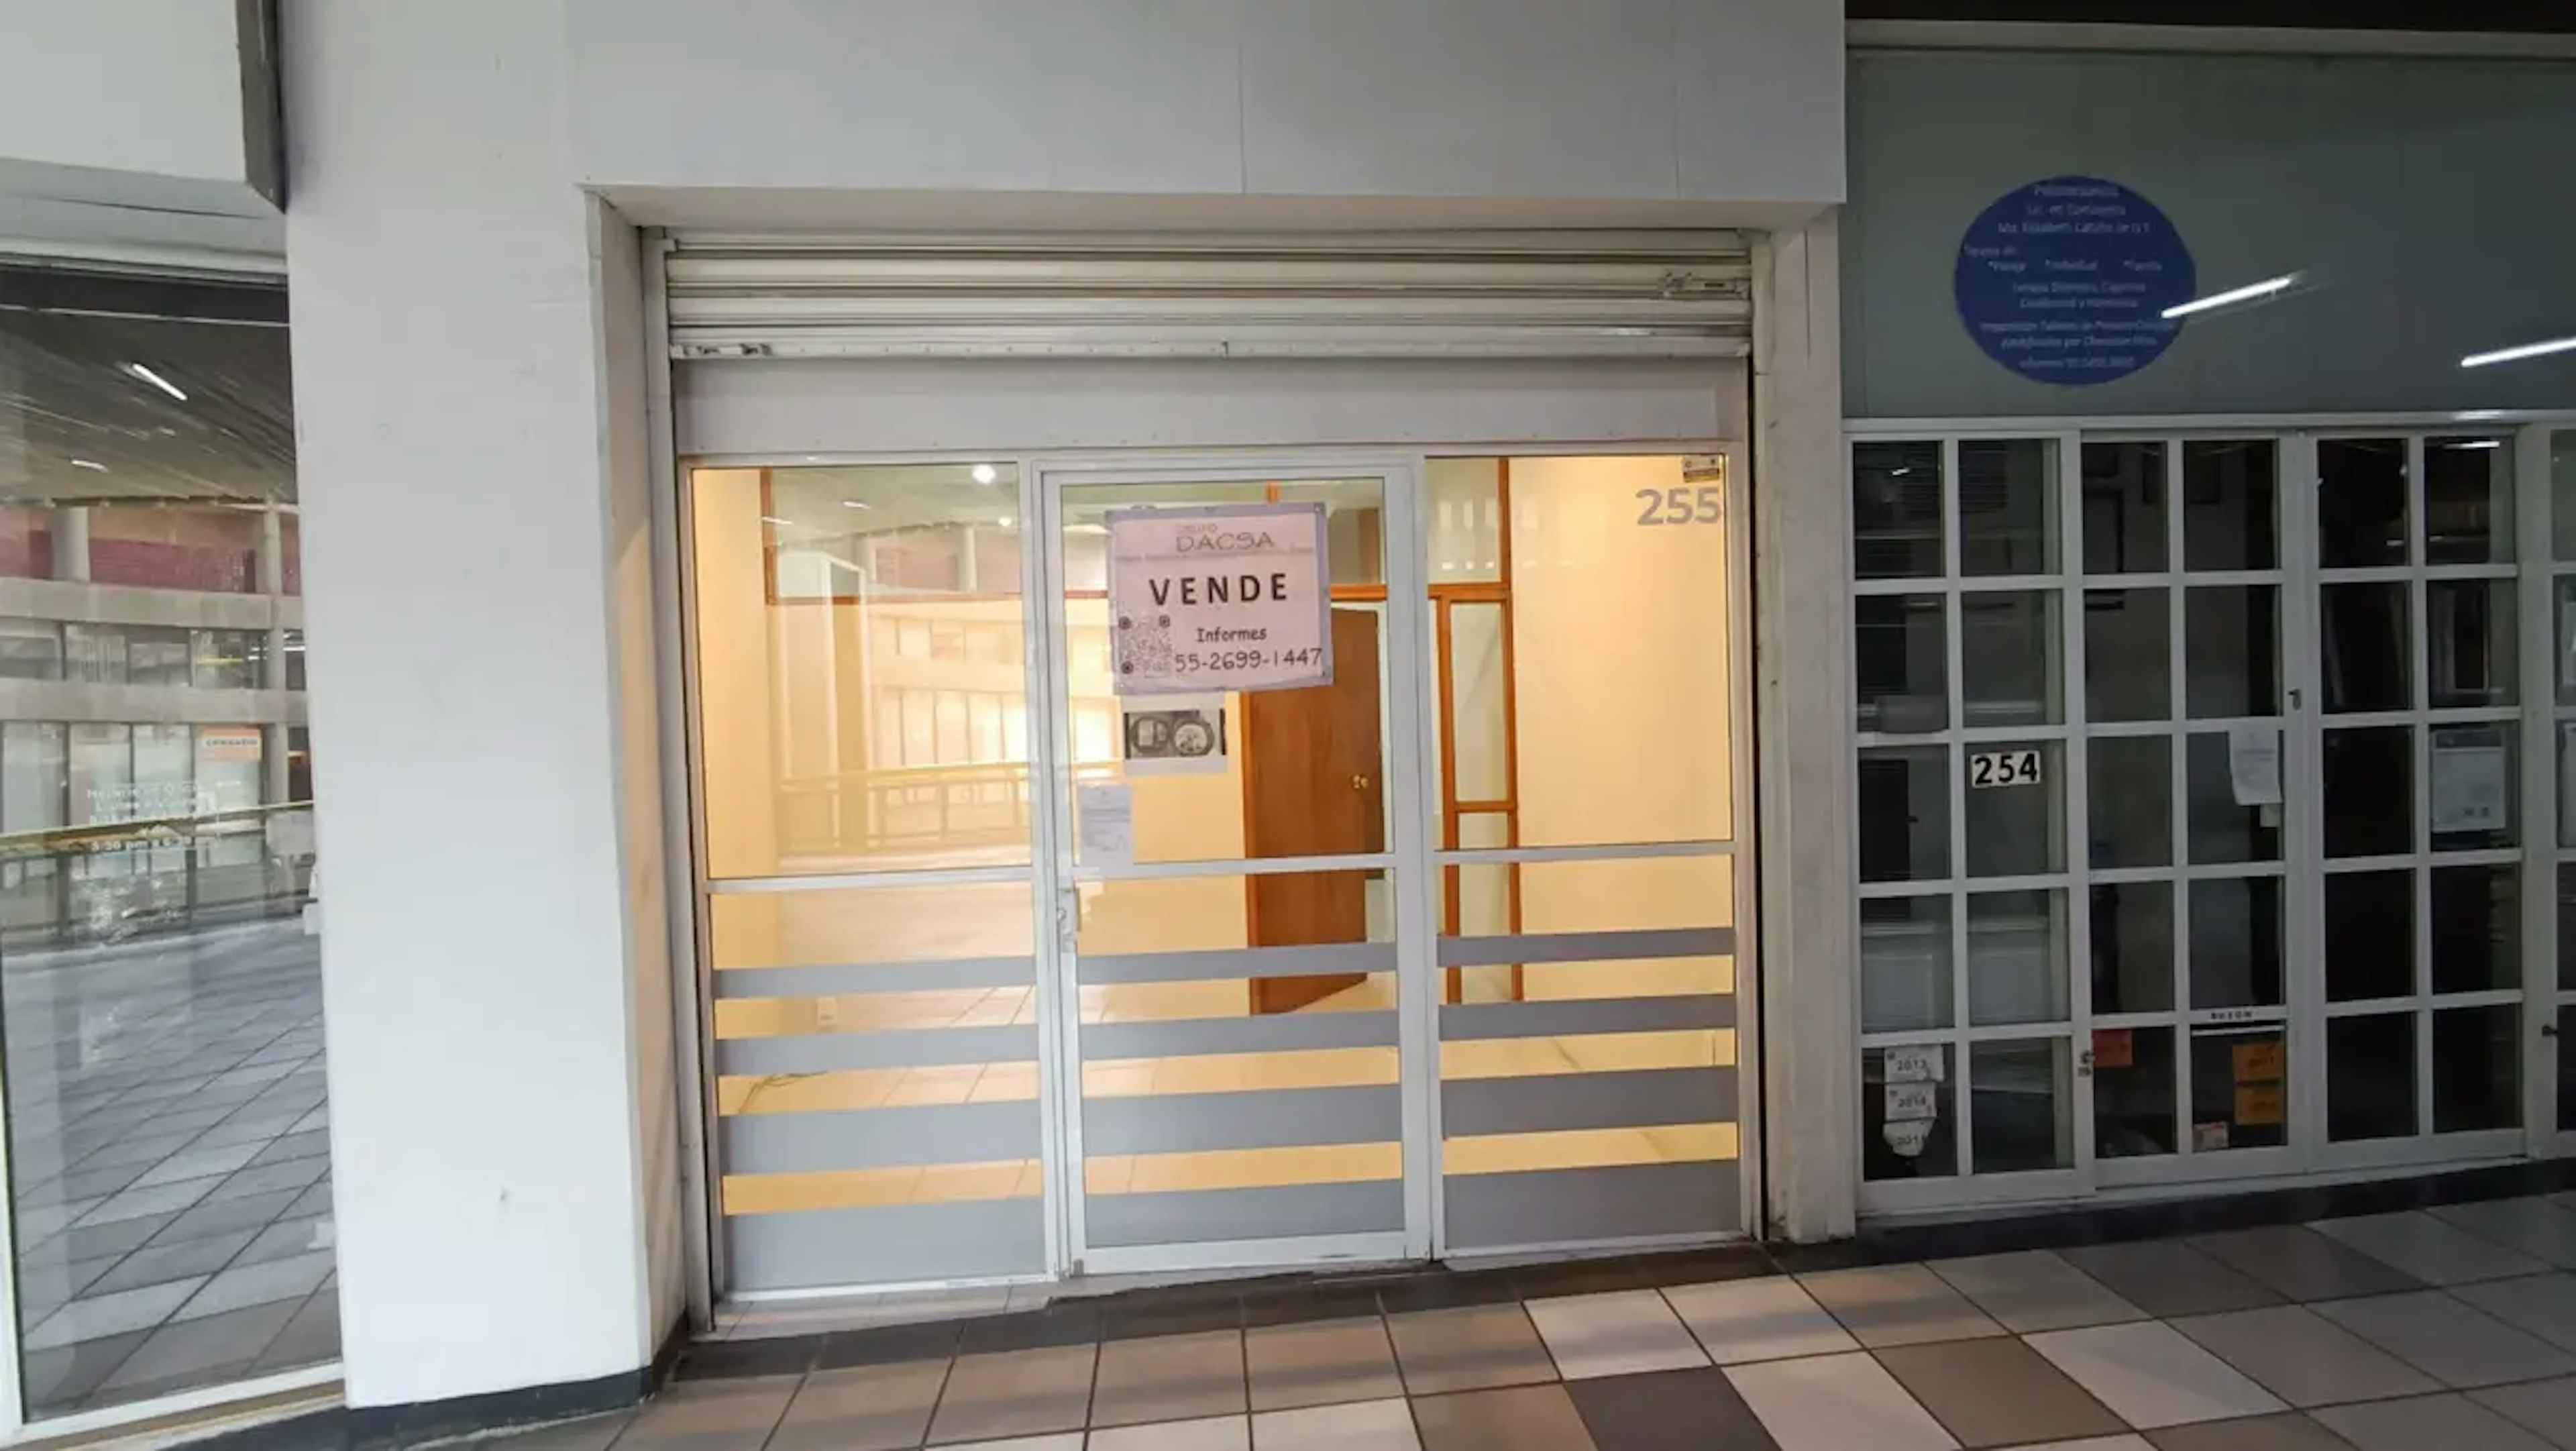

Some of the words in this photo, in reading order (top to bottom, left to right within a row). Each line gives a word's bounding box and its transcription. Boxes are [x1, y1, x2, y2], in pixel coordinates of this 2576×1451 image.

[1635, 486, 1722, 525] 255
[1176, 531, 1275, 553] DACSA
[1148, 573, 1287, 606] VENDE
[1196, 627, 1268, 643] Informes
[1175, 647, 1323, 671] 55-2699-1447
[1974, 753, 2037, 784] 254
